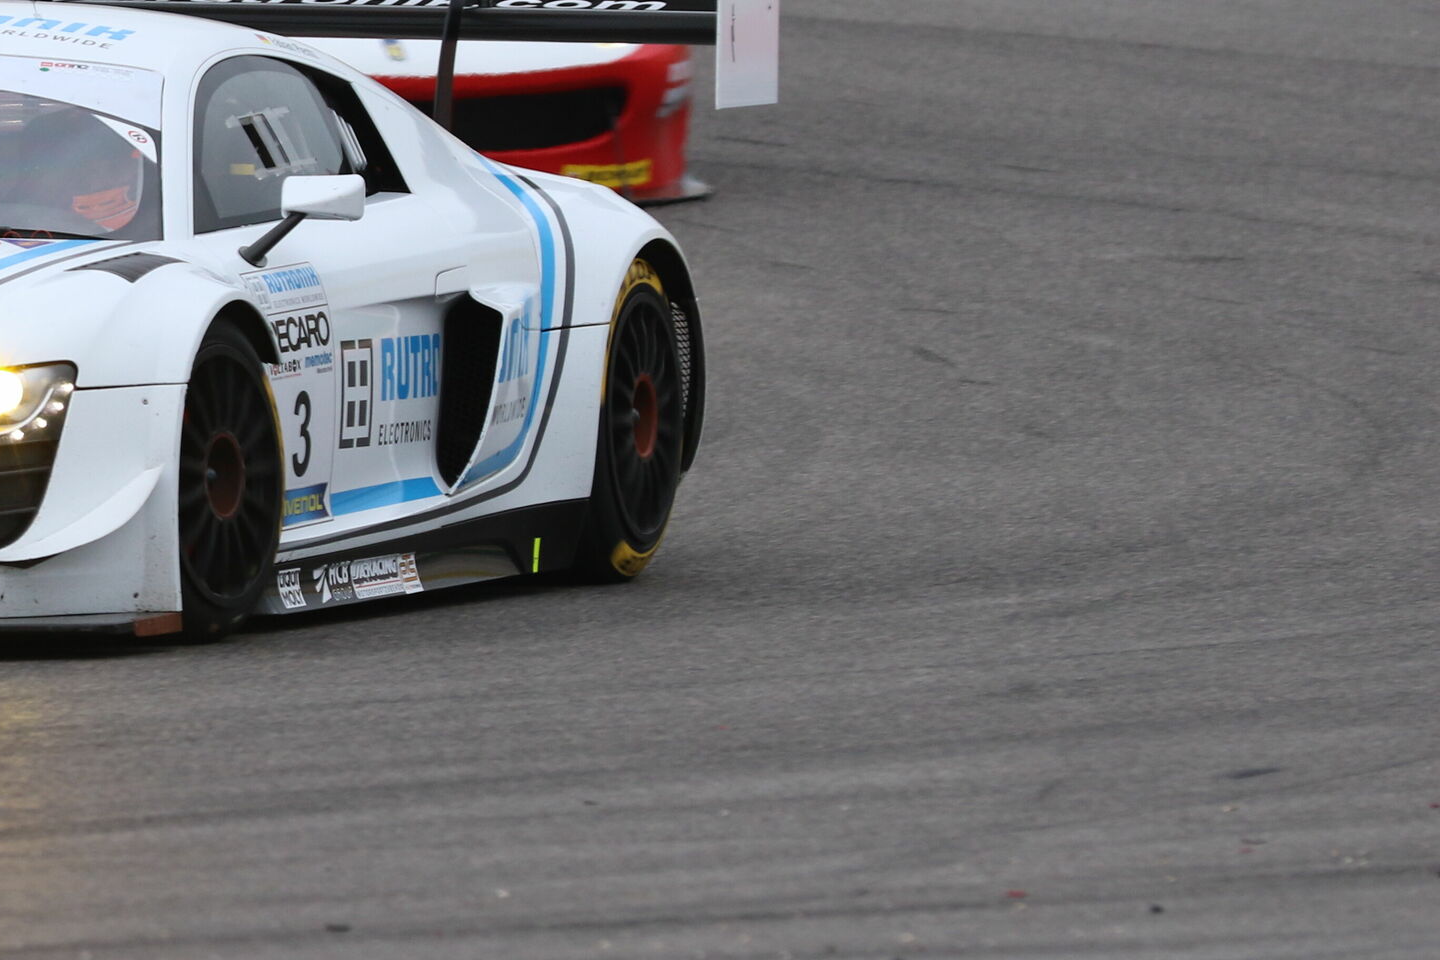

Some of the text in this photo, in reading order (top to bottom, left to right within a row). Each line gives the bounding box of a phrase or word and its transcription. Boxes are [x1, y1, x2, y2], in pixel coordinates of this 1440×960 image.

[262, 266, 320, 294] RUTRONIK
[292, 390, 311, 478] 3
[378, 419, 432, 446] ELECTRONICS
[283, 493, 324, 516] VENOL
